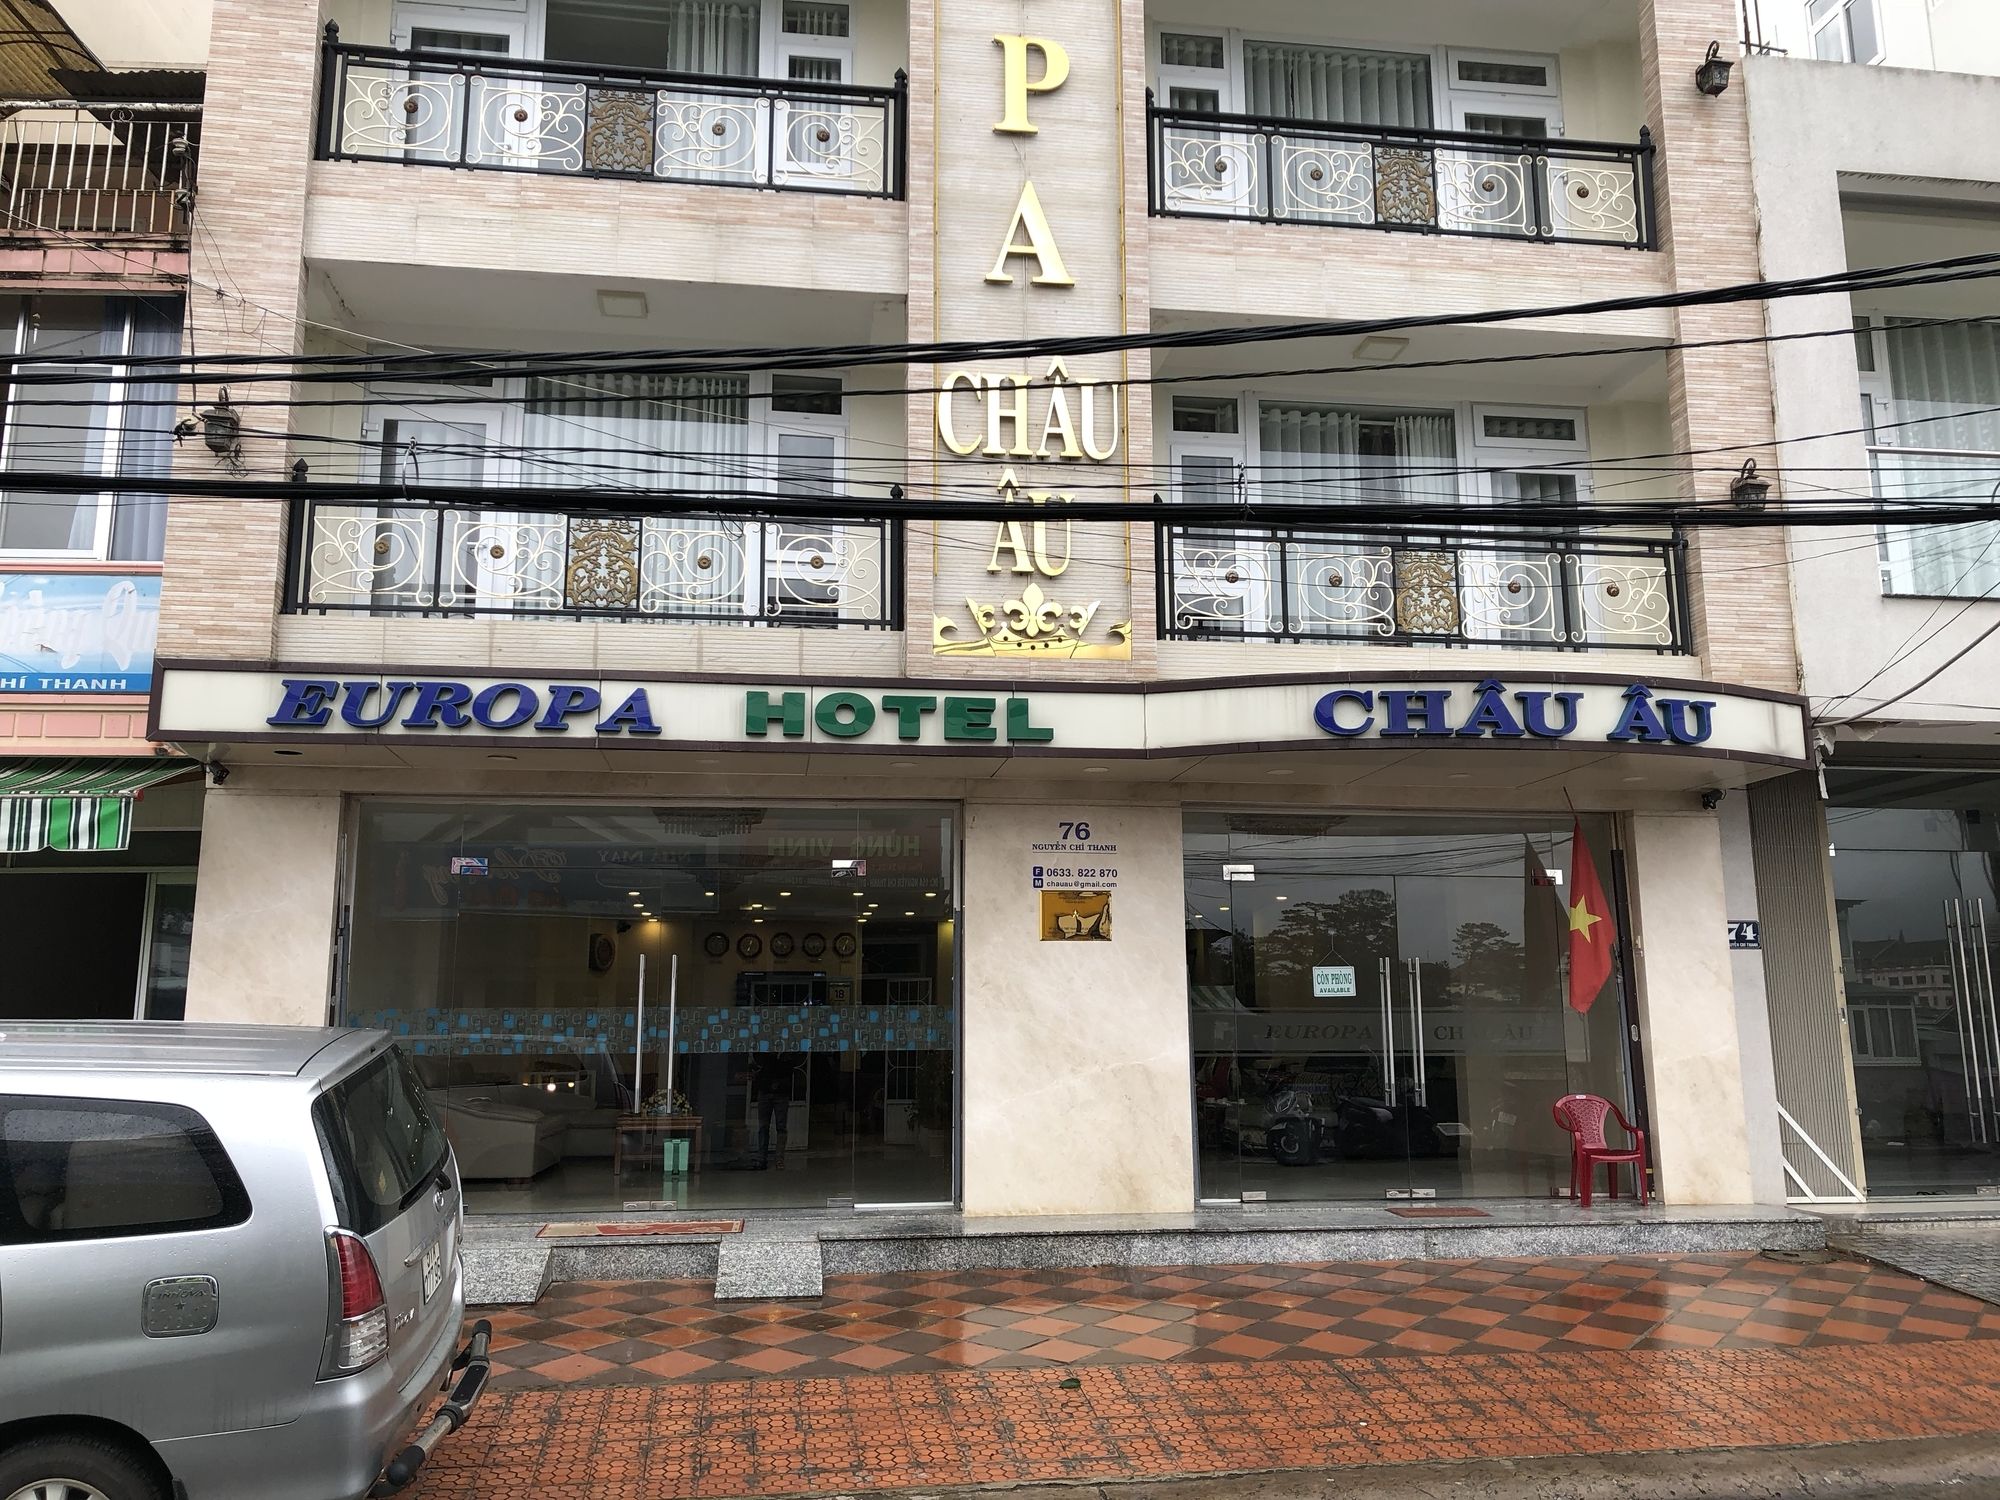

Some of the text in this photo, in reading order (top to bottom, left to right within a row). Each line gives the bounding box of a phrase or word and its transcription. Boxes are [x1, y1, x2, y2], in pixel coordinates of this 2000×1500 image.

[938, 354, 1119, 461] CHÂU
[986, 467, 1076, 578] ÂU
[38, 678, 127, 690] THANH
[265, 679, 1717, 745] EUROPA HOTEL CHÂU ÂU
[1058, 821, 1091, 841] 76
[1087, 844, 1117, 852] THANH
[1046, 868, 1074, 878] 0633.
[1077, 868, 1096, 878] 822
[1099, 869, 1118, 878] 870
[1728, 922, 1757, 940] 74
[1316, 970, 1352, 985] CÒN PHÒNG
[1264, 1024, 1374, 1040] EUROPA
